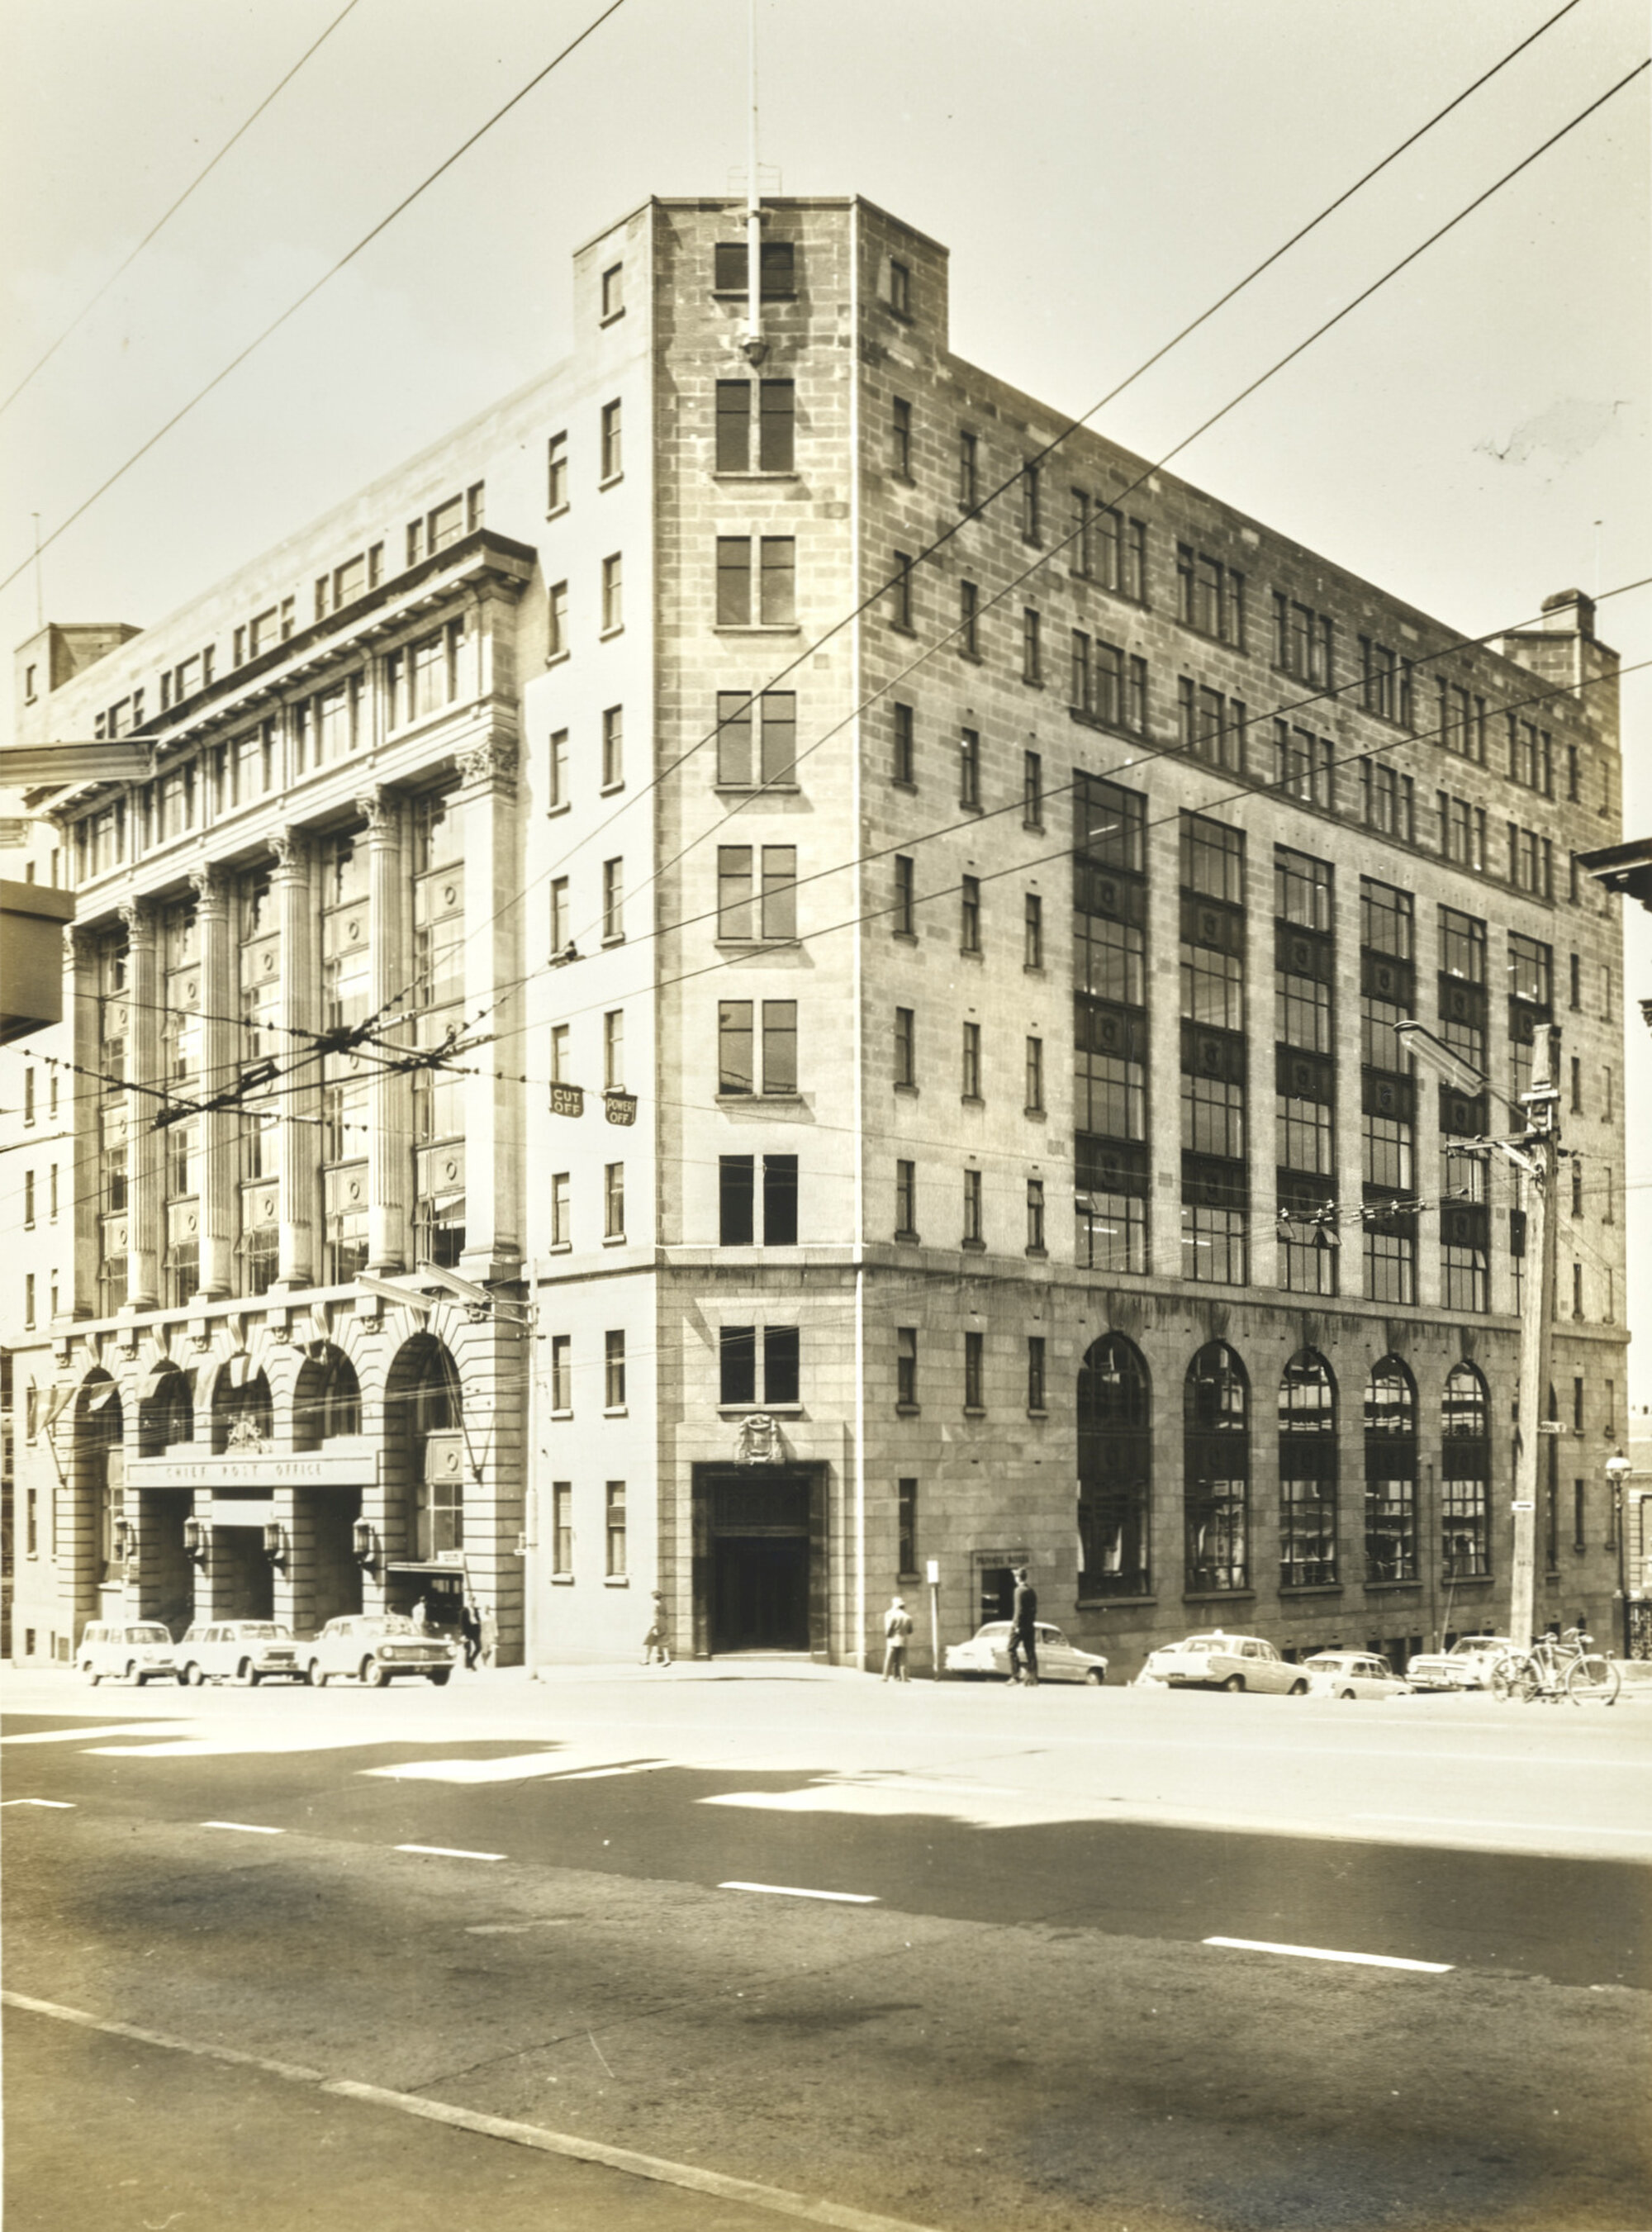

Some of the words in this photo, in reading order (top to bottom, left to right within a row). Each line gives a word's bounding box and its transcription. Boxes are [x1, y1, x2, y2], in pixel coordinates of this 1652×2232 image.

[553, 1089, 580, 1103] CUT
[553, 1101, 580, 1115] OFF
[606, 1098, 634, 1112] POWER
[610, 1111, 629, 1124] OFF
[166, 1466, 206, 1479] CHIEF
[222, 1465, 258, 1476] POST
[277, 1464, 322, 1475] OFFICE
